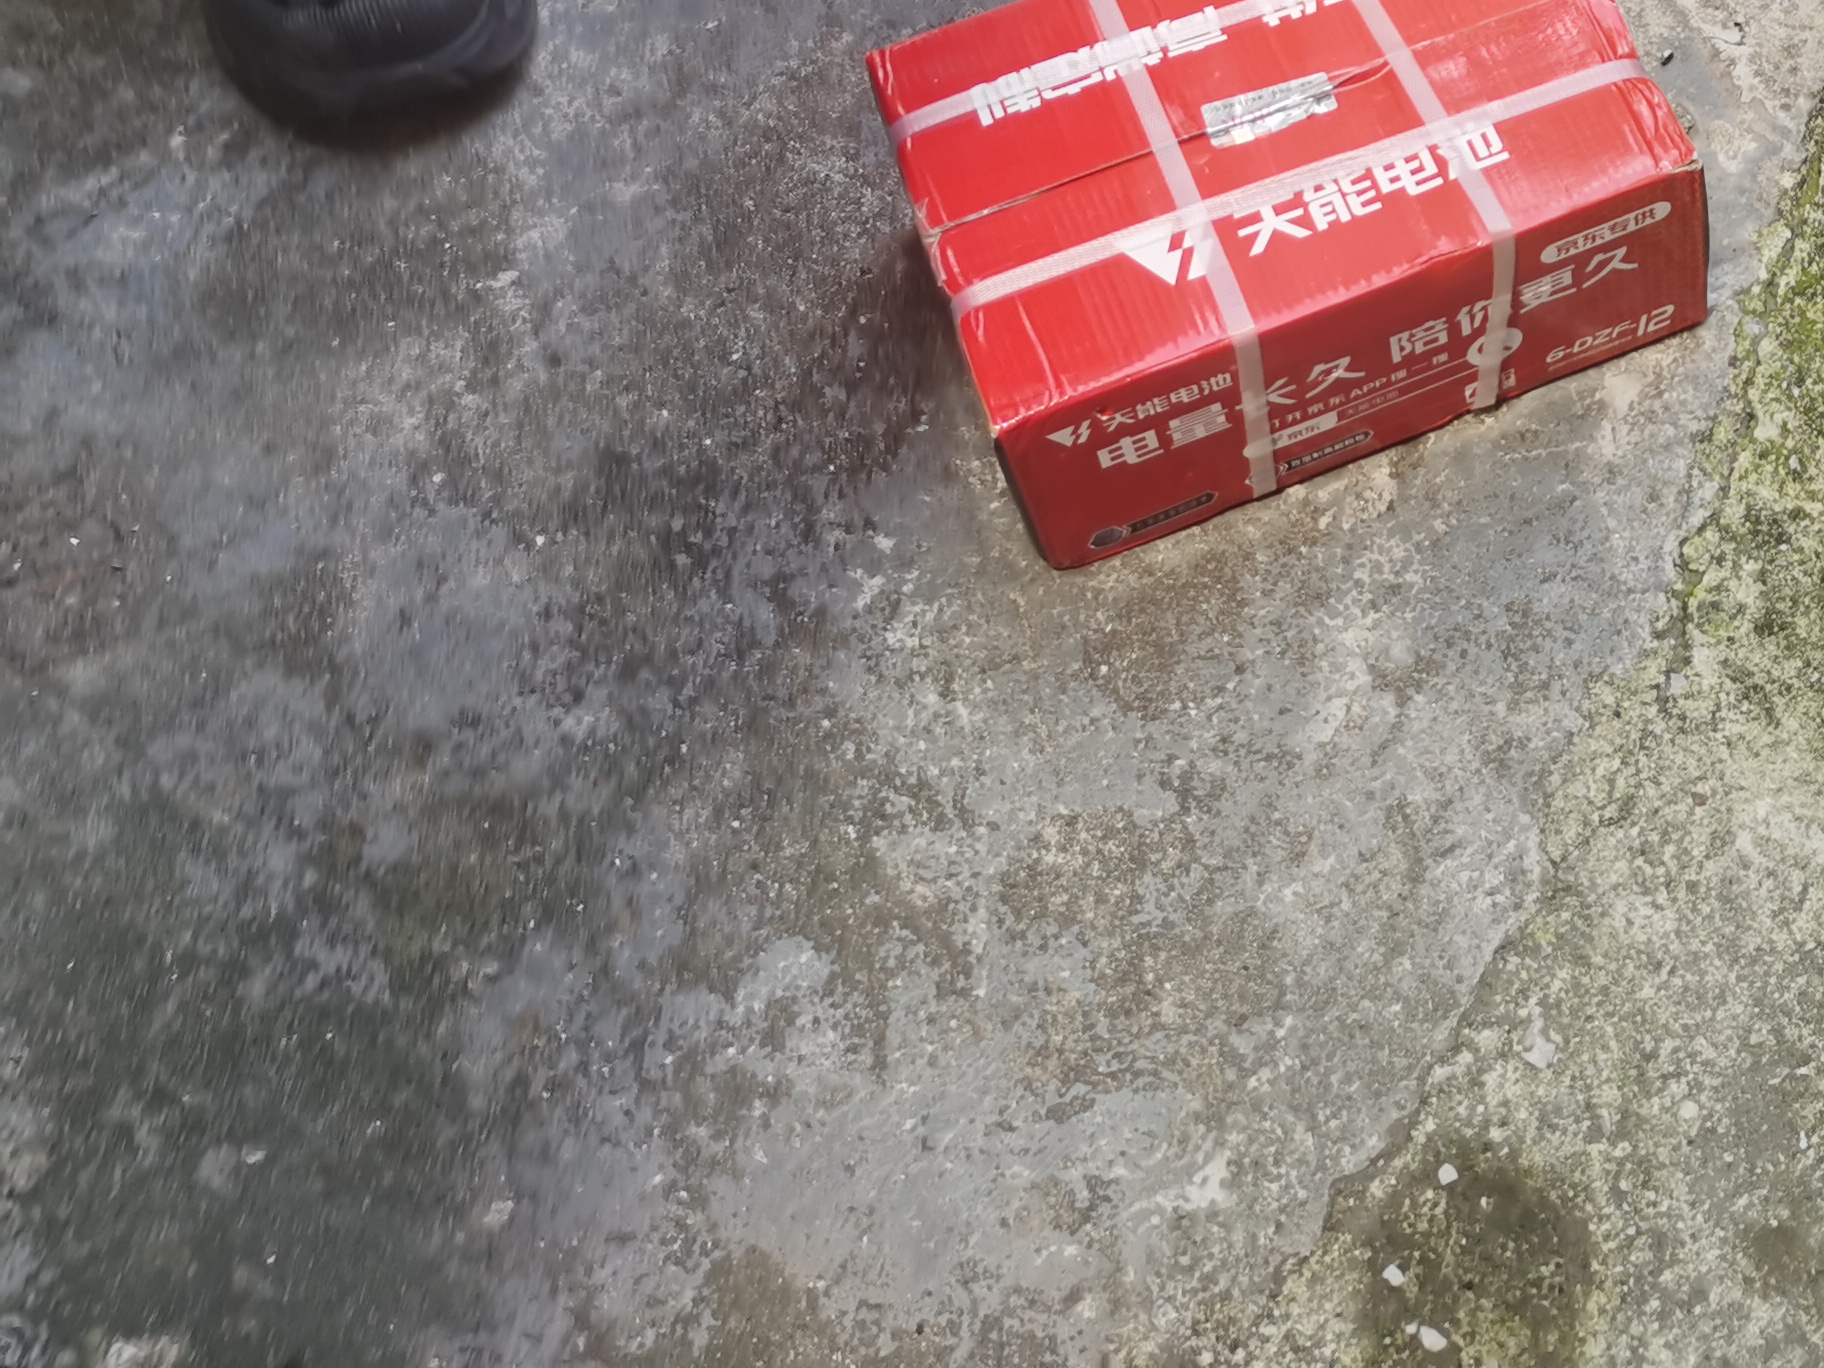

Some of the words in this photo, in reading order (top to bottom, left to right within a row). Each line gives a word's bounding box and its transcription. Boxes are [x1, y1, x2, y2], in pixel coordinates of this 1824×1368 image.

[1232, 120, 1511, 257] 天能电池
[1555, 206, 1658, 258] 京东专供
[1545, 304, 1675, 364] 6-DZF-12
[1102, 371, 1234, 433] 天能电池
